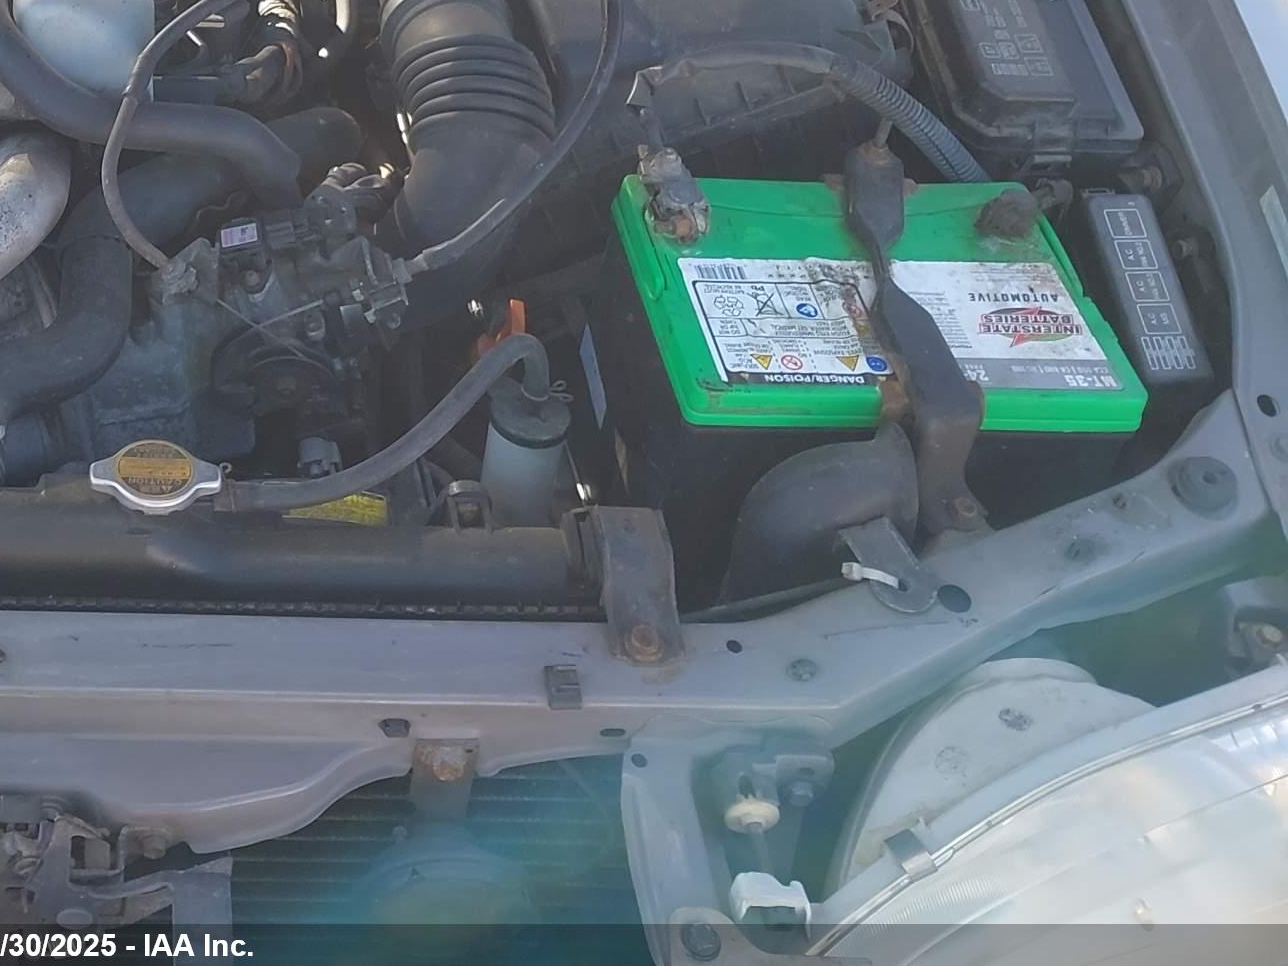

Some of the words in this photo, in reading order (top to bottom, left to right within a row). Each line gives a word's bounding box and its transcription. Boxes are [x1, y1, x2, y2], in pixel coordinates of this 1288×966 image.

[968, 292, 1059, 303] AUTOMOTIVE
[982, 314, 1073, 324] BATTERIES
[983, 324, 1081, 334] INTERSTATE
[764, 374, 865, 384] DANGER/POISON
